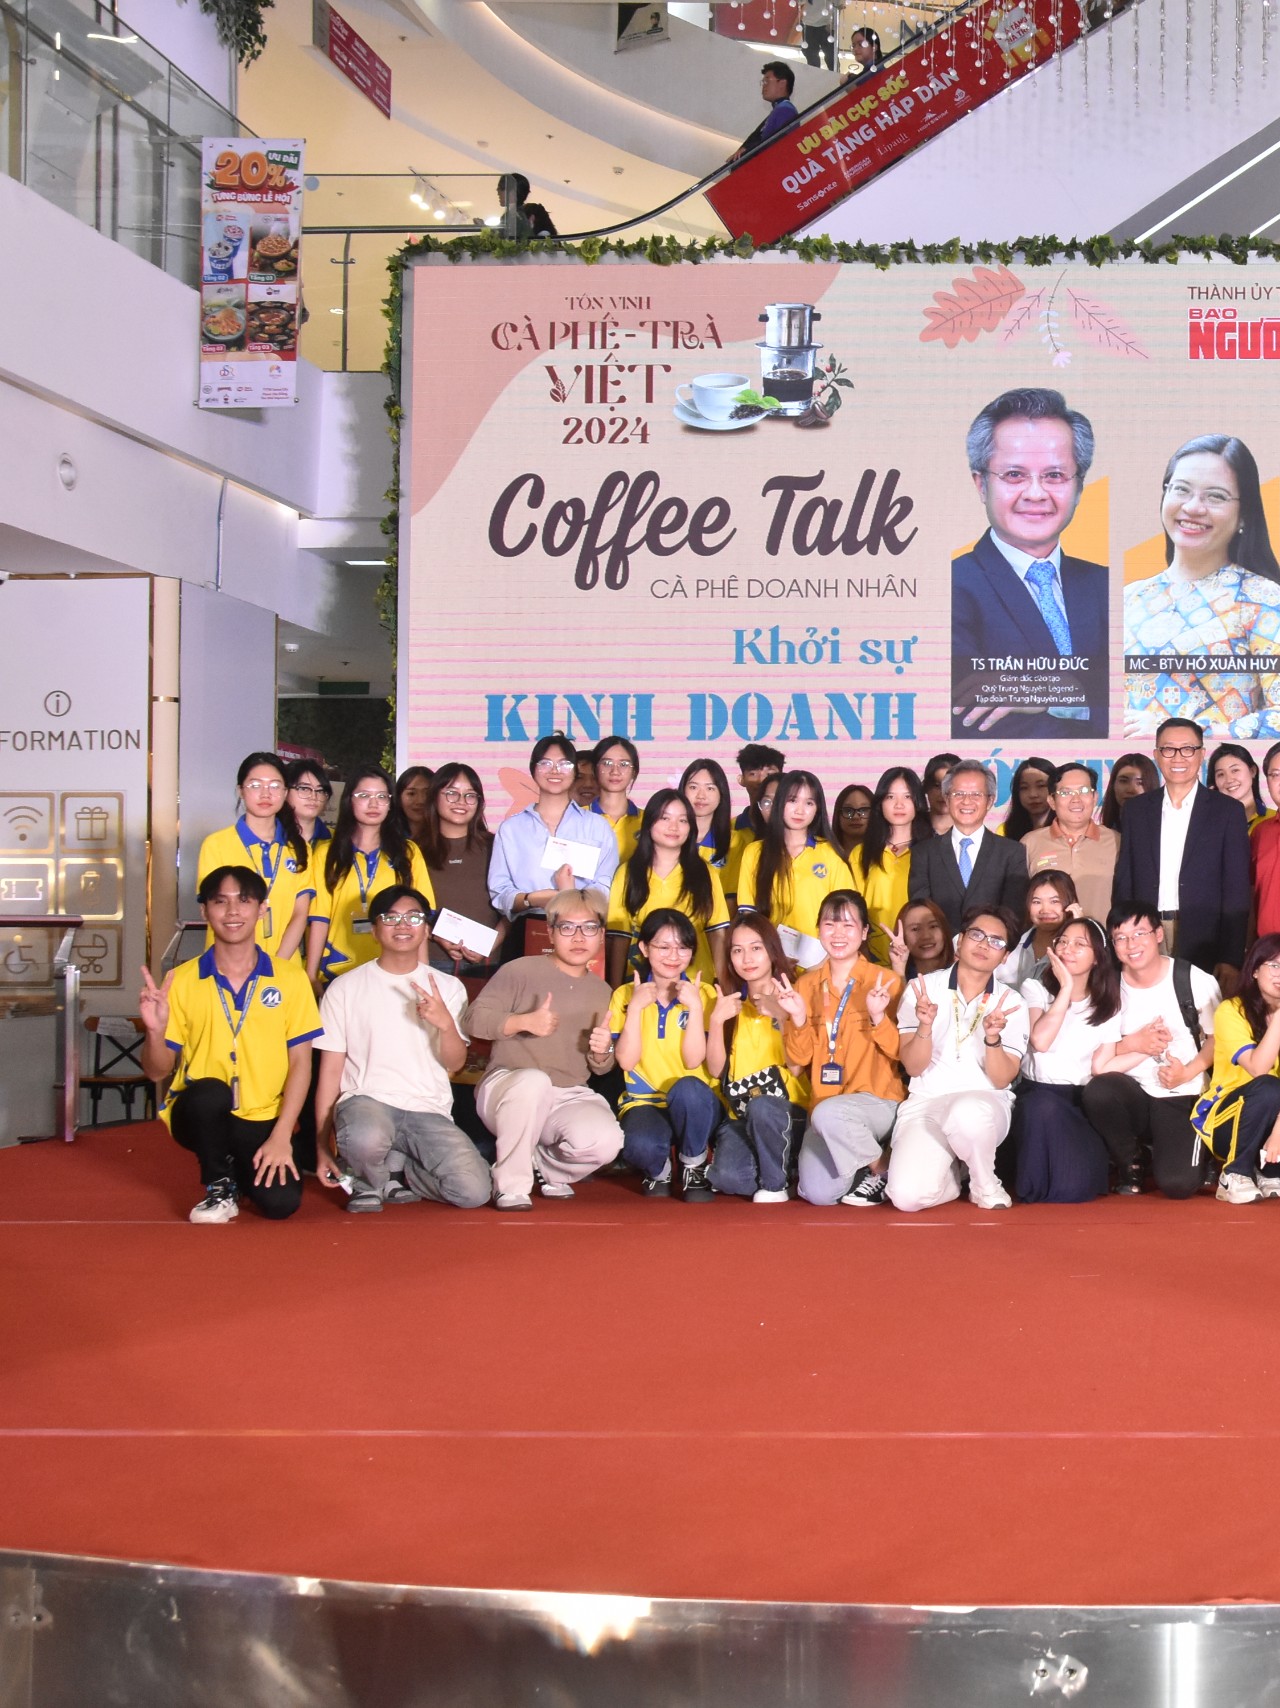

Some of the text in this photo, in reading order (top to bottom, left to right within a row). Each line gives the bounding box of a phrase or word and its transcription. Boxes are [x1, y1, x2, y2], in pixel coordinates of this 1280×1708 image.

[796, 75, 911, 155] ƯU ĐÃI CỰC SỐC
[268, 152, 298, 165] ƯU ĐÃI
[781, 157, 826, 194] QUÀ
[821, 123, 877, 166] TẶNG
[873, 97, 916, 132] HẤP
[214, 150, 287, 191] 20%
[238, 192, 262, 203] BỪNG
[262, 190, 274, 203] LỄ
[274, 194, 292, 205] HỘI
[796, 180, 838, 211] Samsonite
[564, 292, 652, 311] TÔN VINH
[1188, 284, 1246, 300] THÀNH
[1251, 283, 1276, 300] ỦY
[491, 314, 541, 351] CÀ
[544, 352, 672, 412] VIỆT
[562, 416, 651, 445] 2024
[488, 468, 919, 591] Coffee Talk
[649, 573, 918, 599] CÀ PHÊ DOANH NHÂN
[732, 625, 919, 675] Khởi sự
[971, 655, 1090, 671] TS TRẦN HỮU ĐỨC
[1129, 655, 1278, 671] MC BTV HỒ XUÂN HUY
[484, 691, 918, 742] KINH DOANH
